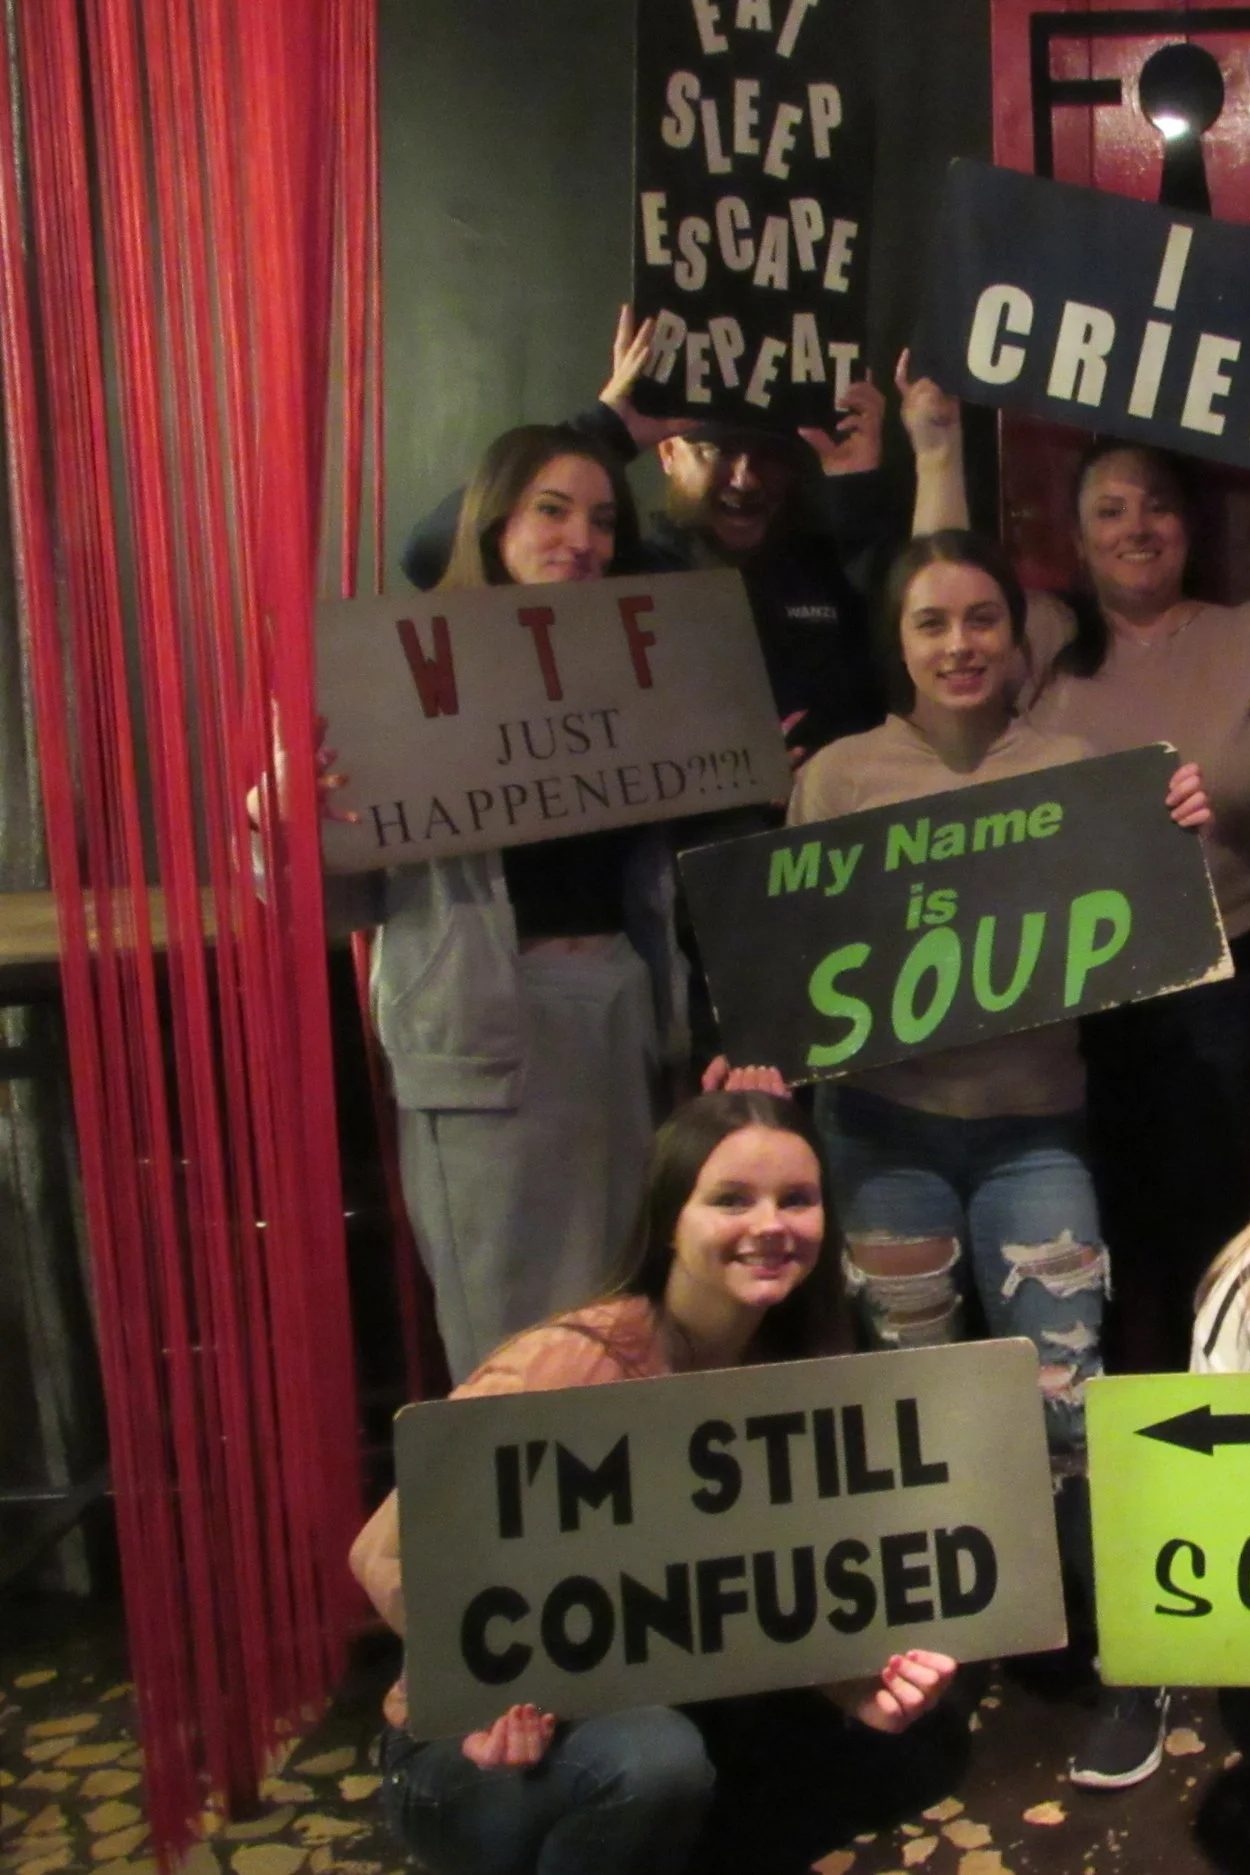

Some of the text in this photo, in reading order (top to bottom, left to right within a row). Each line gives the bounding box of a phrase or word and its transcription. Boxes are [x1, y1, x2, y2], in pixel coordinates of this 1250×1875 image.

[661, 70, 842, 180] SLEEP
[641, 192, 858, 292] ESCAPE
[1153, 224, 1193, 311] I
[645, 308, 859, 411] REPEAT
[497, 708, 621, 765] JUST
[370, 747, 759, 848] HAPPENED?!?!
[767, 801, 1063, 897] My Name
[906, 882, 959, 930] is
[806, 889, 1132, 1068] SOUP
[494, 1398, 949, 1538] I'M STILL
[460, 1524, 998, 1685] CONFUSED
